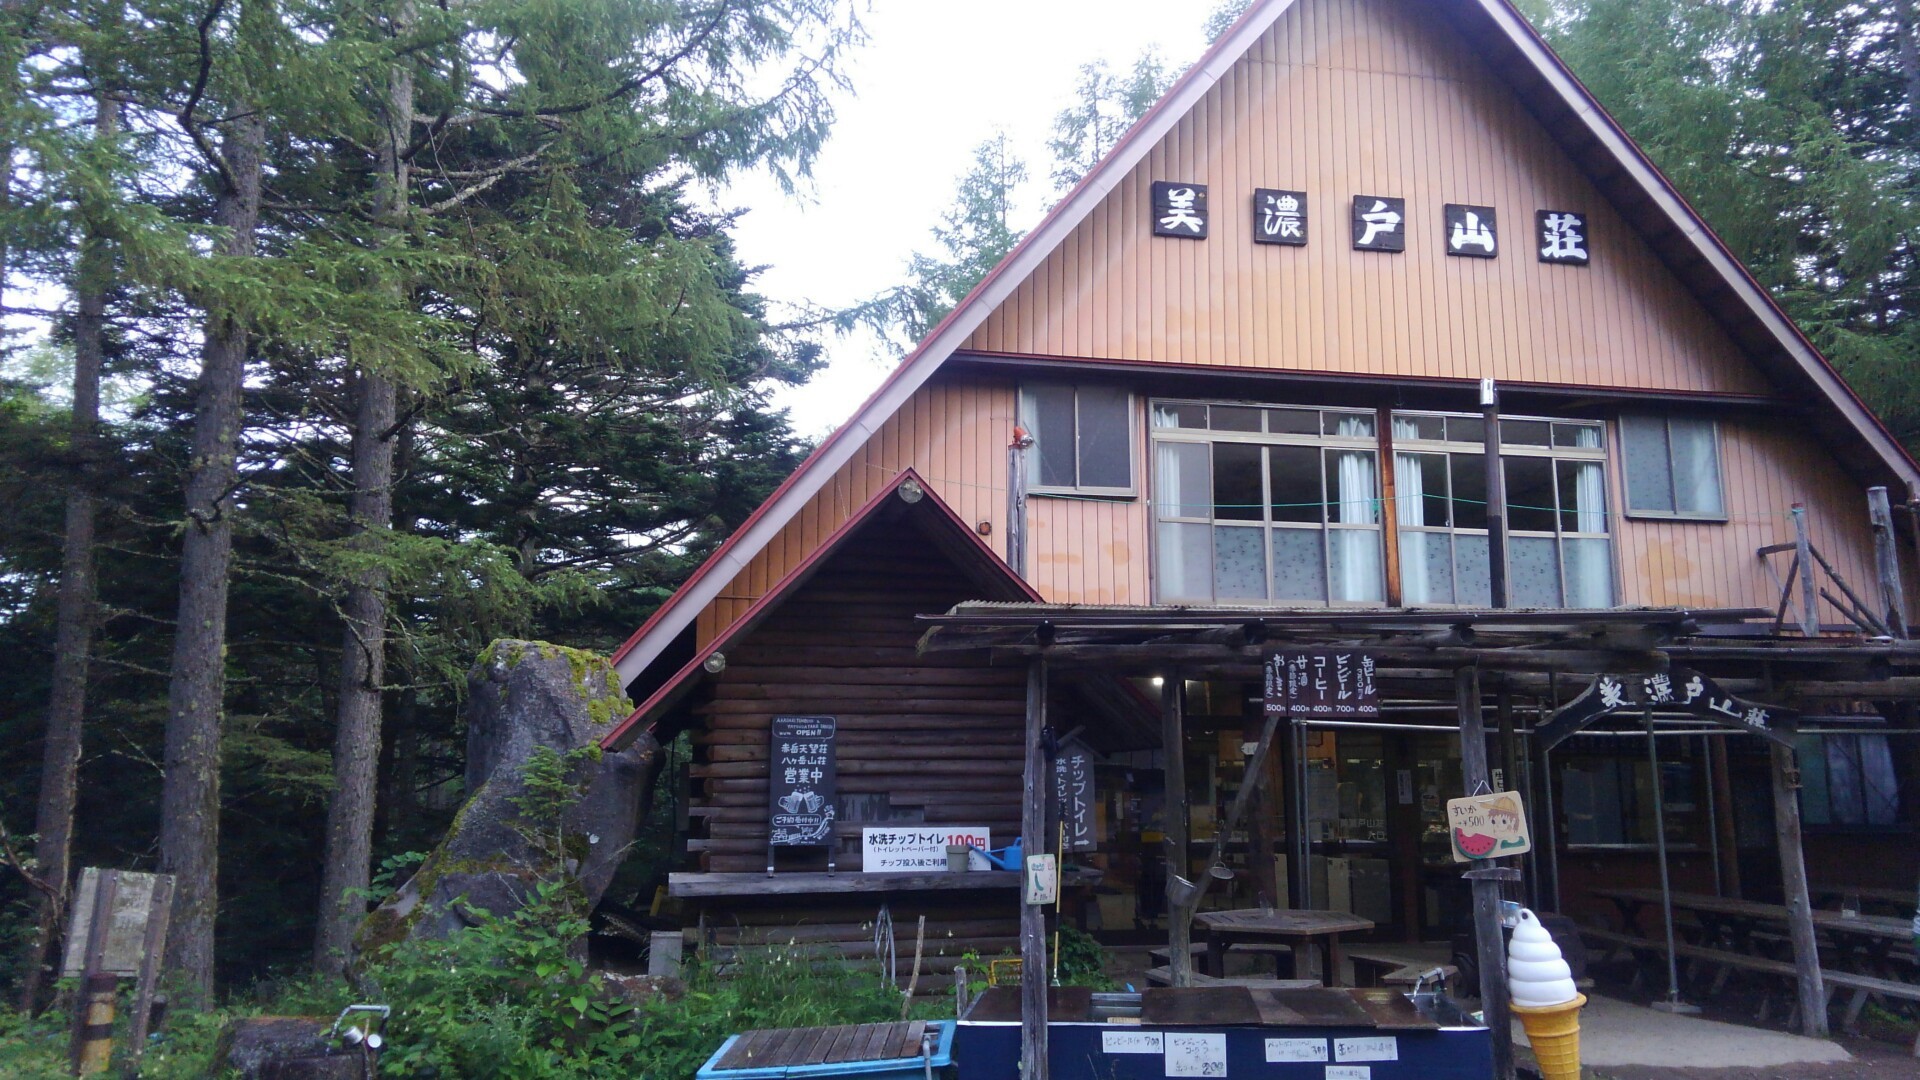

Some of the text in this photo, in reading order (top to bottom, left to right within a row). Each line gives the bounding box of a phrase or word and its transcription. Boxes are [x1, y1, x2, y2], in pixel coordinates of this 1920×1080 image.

[1160, 188, 1588, 260] 美濃戸山荘
[1295, 655, 1308, 686] 甘酒
[1314, 656, 1327, 700] コーヒー
[1361, 655, 1376, 695] 生ビール
[1600, 674, 1771, 732] 美濃戸山荘
[781, 742, 828, 754] 赤岳天望荘
[784, 766, 823, 784] 営業中
[1071, 755, 1088, 837] チップトイレ
[1452, 804, 1477, 817] すいか
[869, 833, 945, 845] 水洗チップトイレ
[880, 858, 976, 867] チップ投入後ご利用
